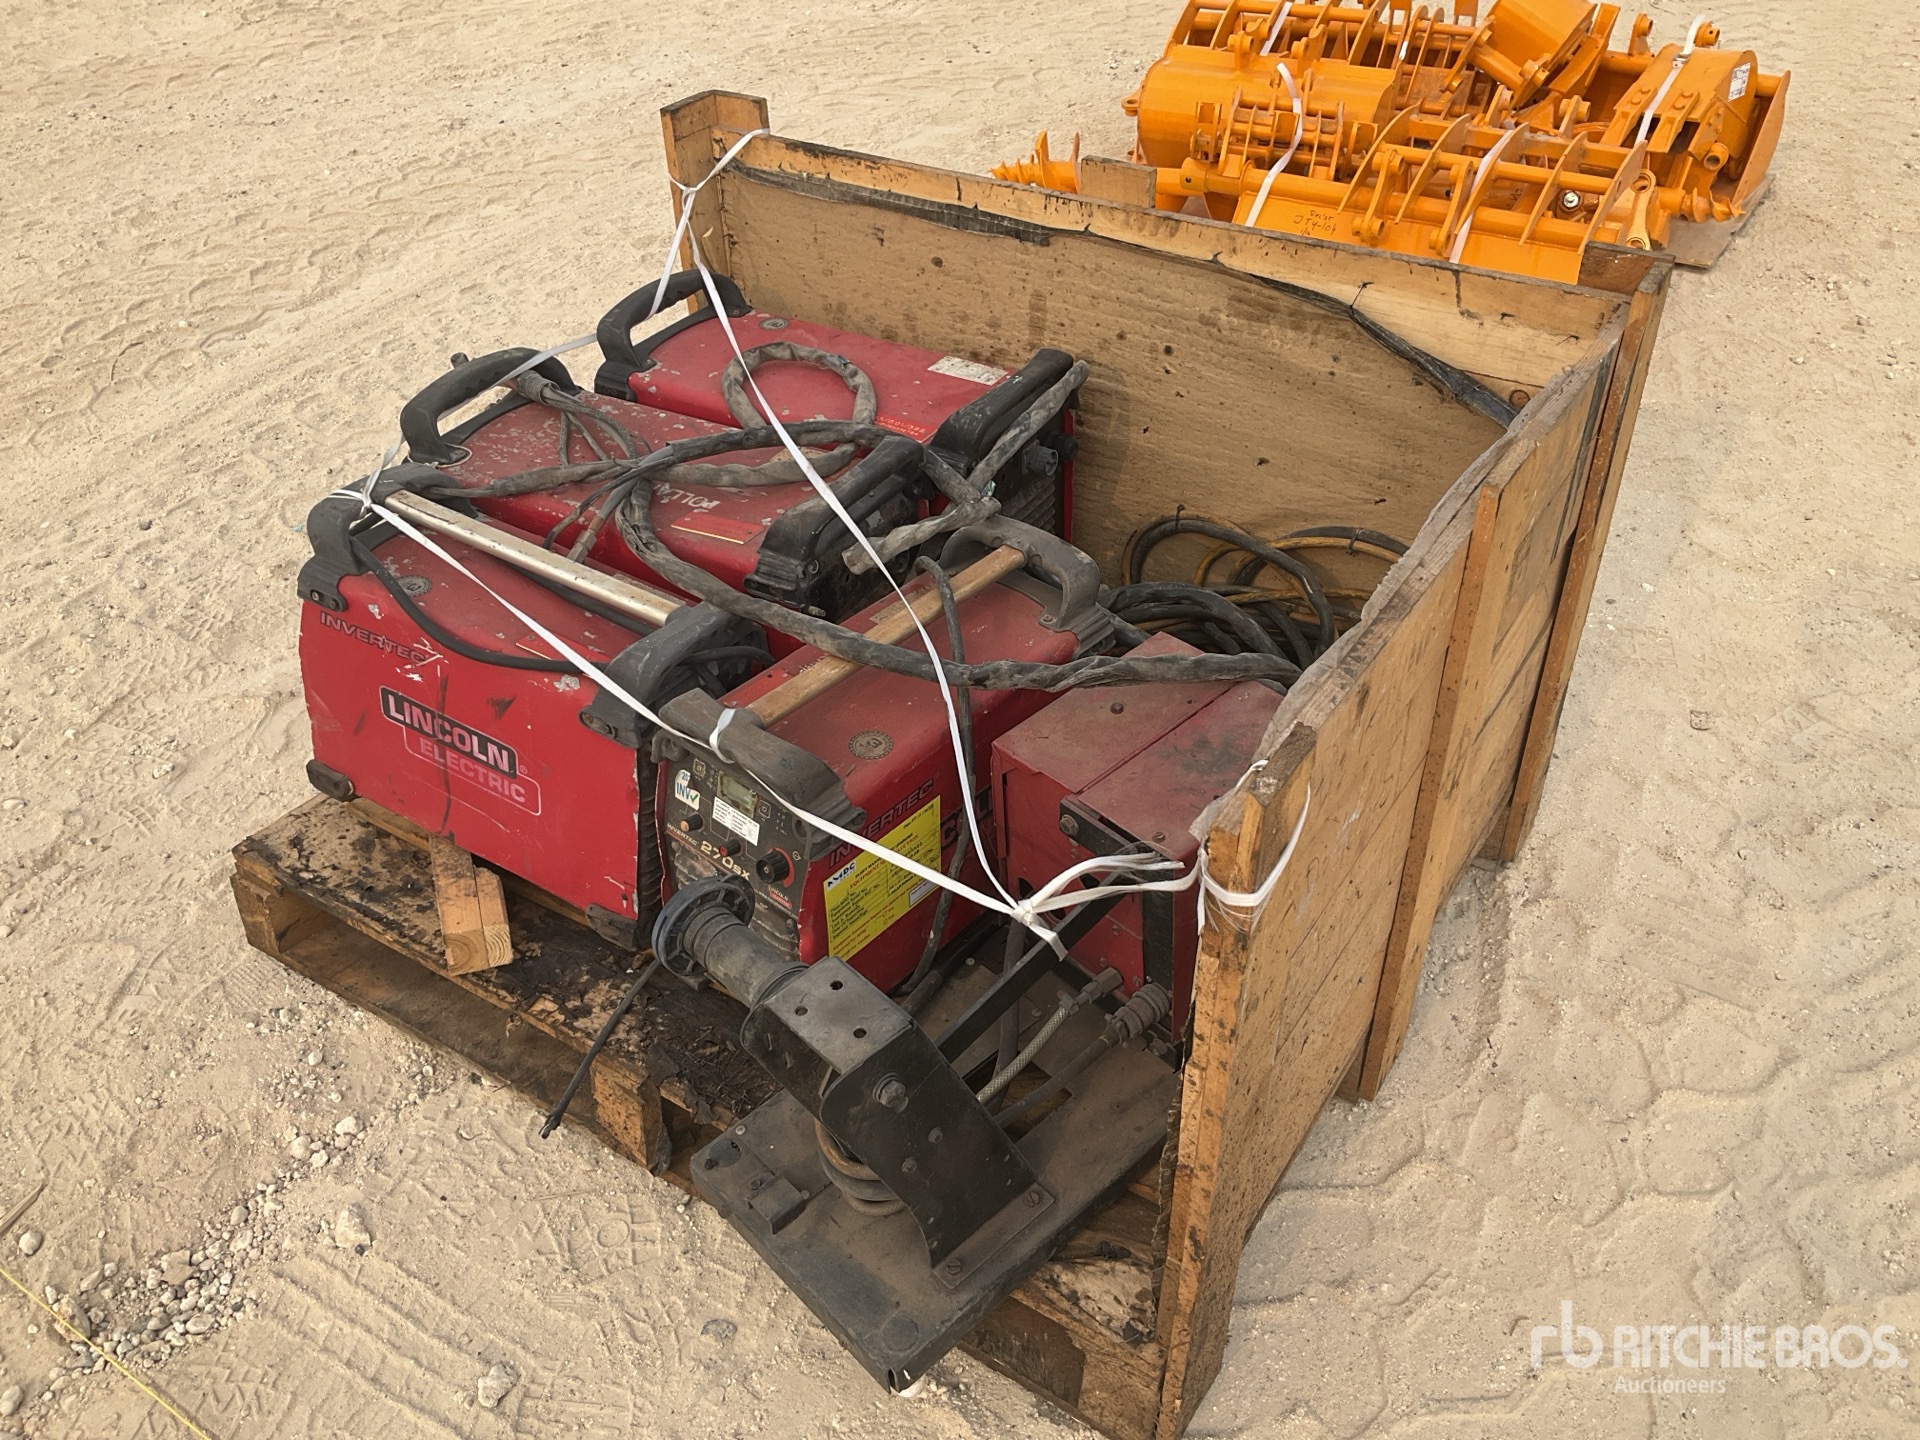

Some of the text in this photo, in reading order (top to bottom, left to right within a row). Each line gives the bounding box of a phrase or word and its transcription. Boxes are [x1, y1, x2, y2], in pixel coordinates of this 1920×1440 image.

[320, 612, 427, 665] INVERTEC
[386, 693, 511, 773] LINCOLN
[419, 737, 527, 804] ELECTRIC
[676, 783, 691, 800] INV
[667, 823, 698, 846] INVERTEC
[829, 780, 933, 867] INERTEC
[849, 864, 878, 889] EQUIPMENT
